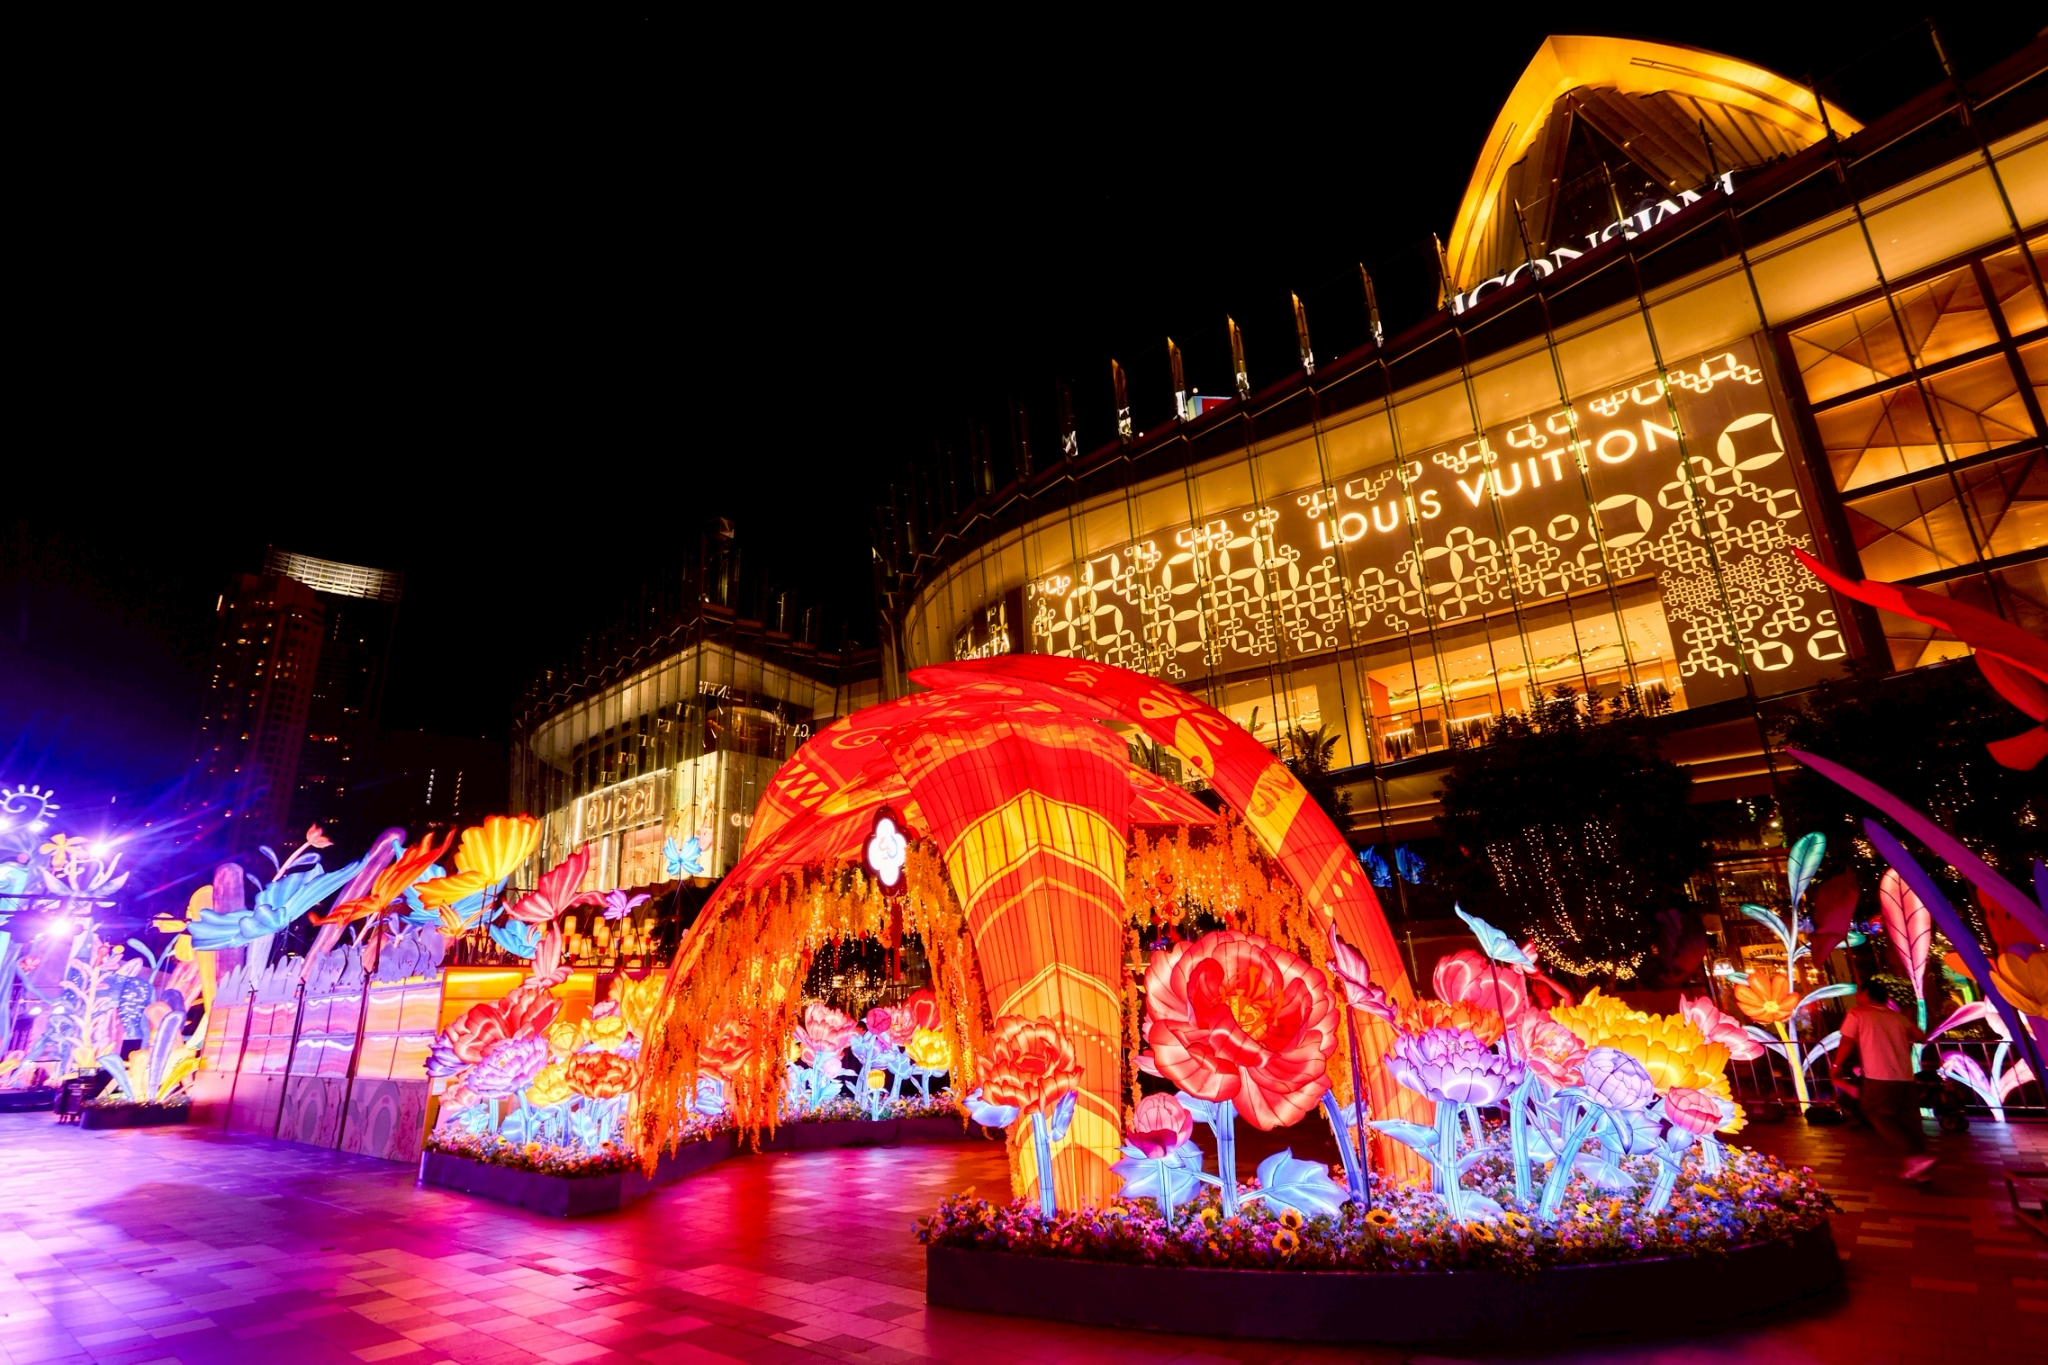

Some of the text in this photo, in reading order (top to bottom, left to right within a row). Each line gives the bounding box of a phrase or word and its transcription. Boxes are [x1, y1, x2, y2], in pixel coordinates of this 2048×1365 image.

[1317, 418, 1681, 549] LOUIS VUITTON
[588, 788, 655, 829] GUCCI
